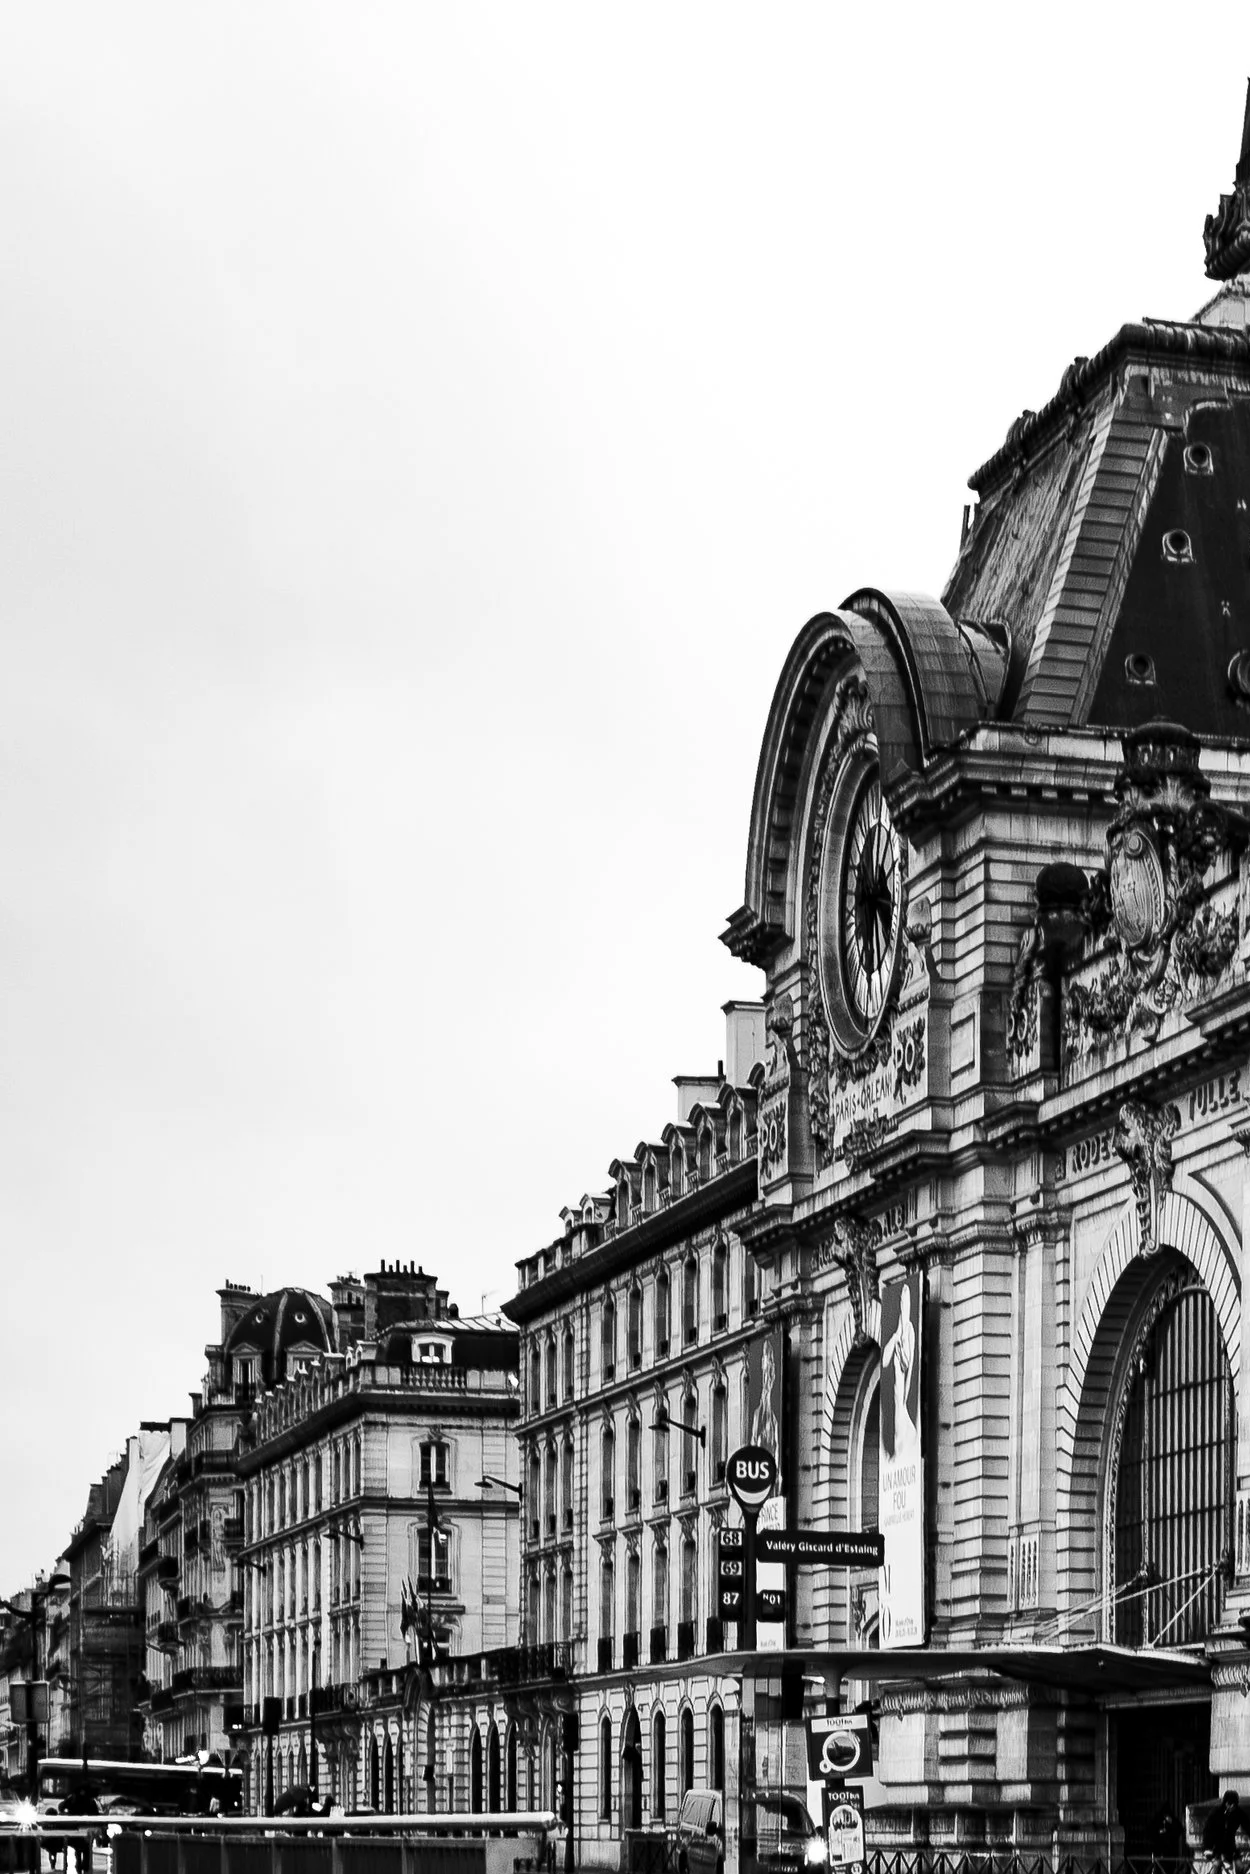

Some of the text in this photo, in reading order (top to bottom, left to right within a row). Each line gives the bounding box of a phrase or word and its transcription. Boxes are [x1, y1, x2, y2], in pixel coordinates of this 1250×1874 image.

[736, 1460, 770, 1480] BUS
[893, 1490, 907, 1511] FOU
[723, 1532, 739, 1546] 68
[766, 1540, 878, 1556] Valéry Giscard d'Estaing
[723, 1562, 739, 1576] 69
[723, 1593, 739, 1605] 87
